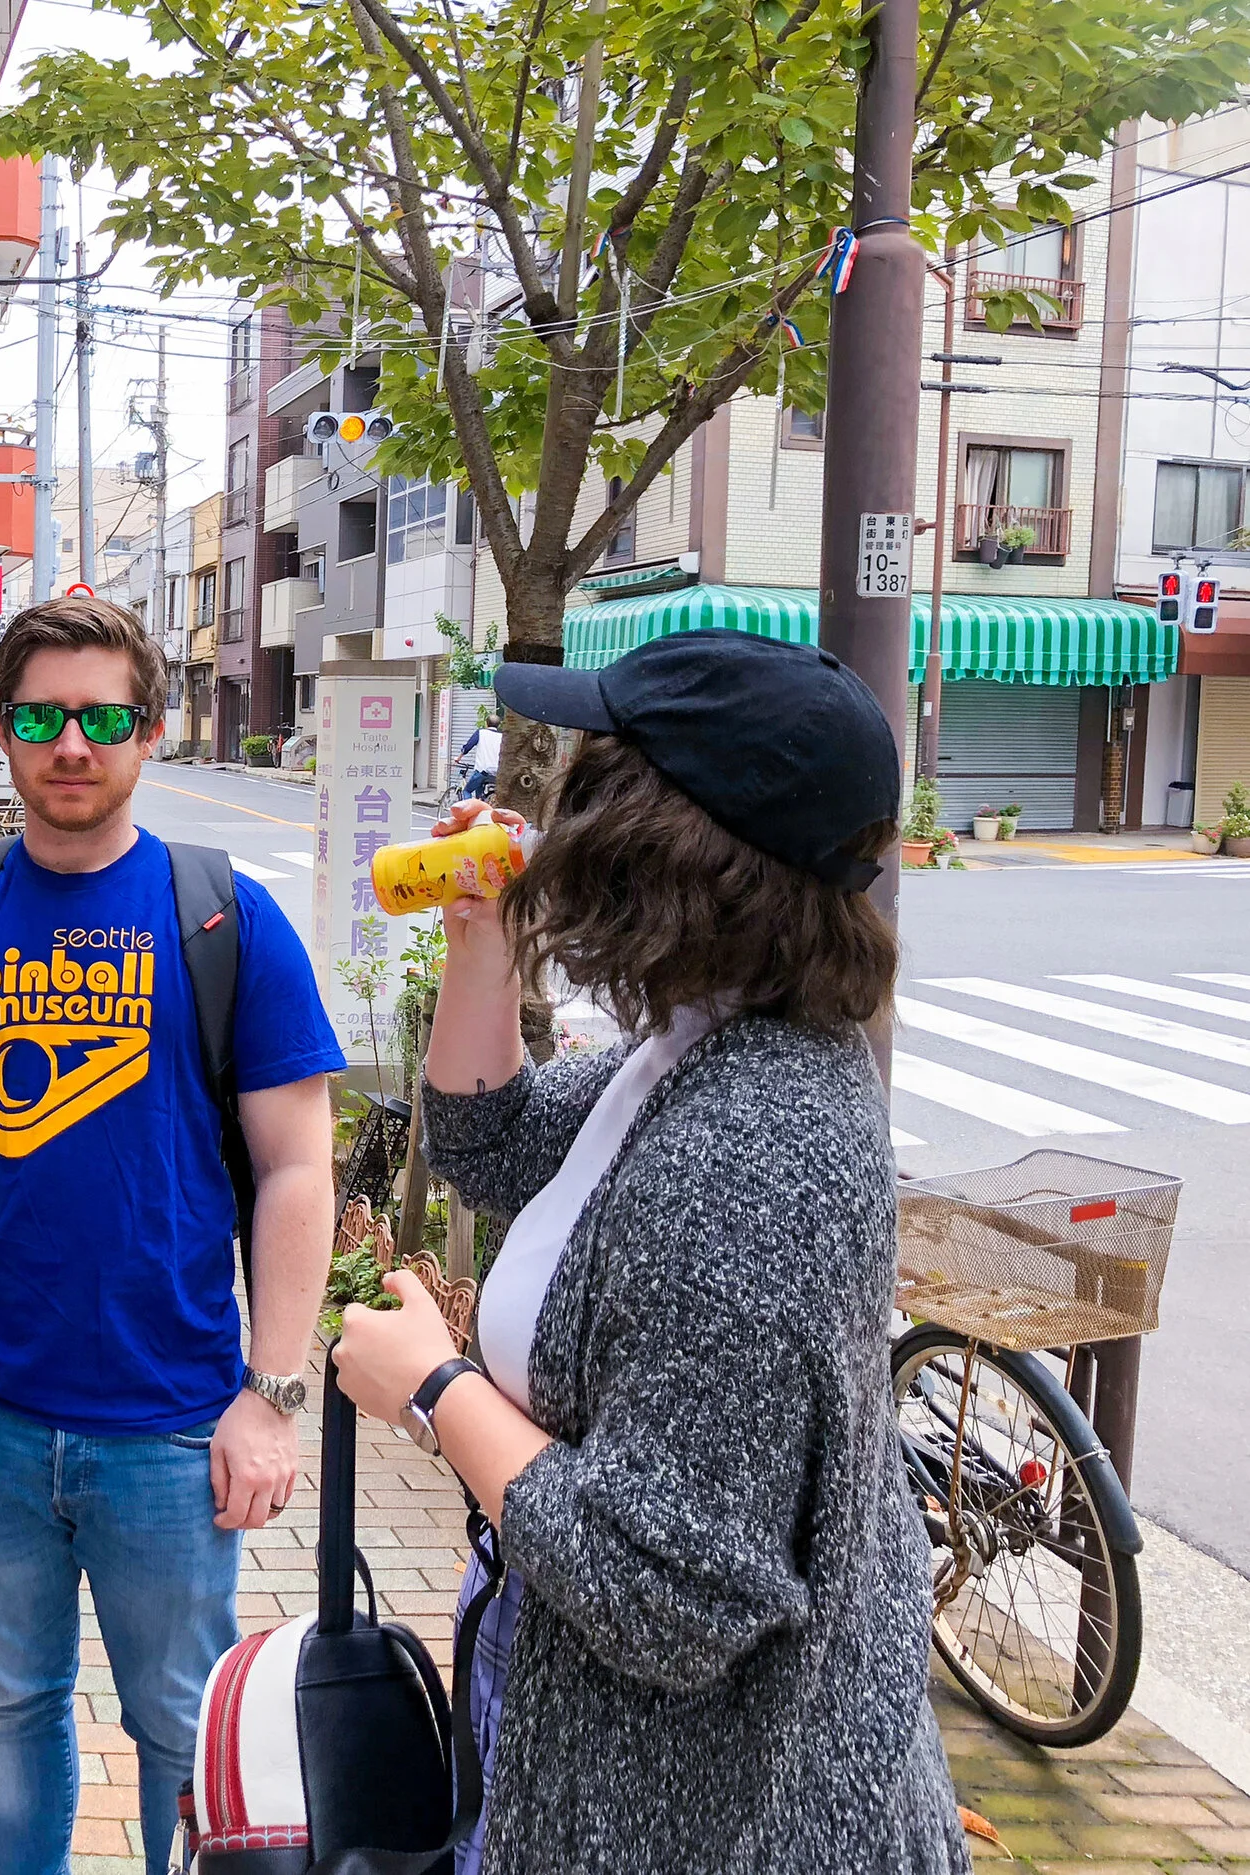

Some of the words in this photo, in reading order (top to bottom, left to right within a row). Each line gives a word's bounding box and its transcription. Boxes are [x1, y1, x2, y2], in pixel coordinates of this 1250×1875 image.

[866, 516, 909, 527] 台東区
[865, 541, 901, 551] 管理番号
[864, 554, 899, 572] 10-
[863, 574, 907, 592] 1387
[362, 732, 389, 742] Taito
[352, 742, 397, 753] Hospital
[345, 764, 403, 778] 台東区立
[52, 926, 155, 950] seattle
